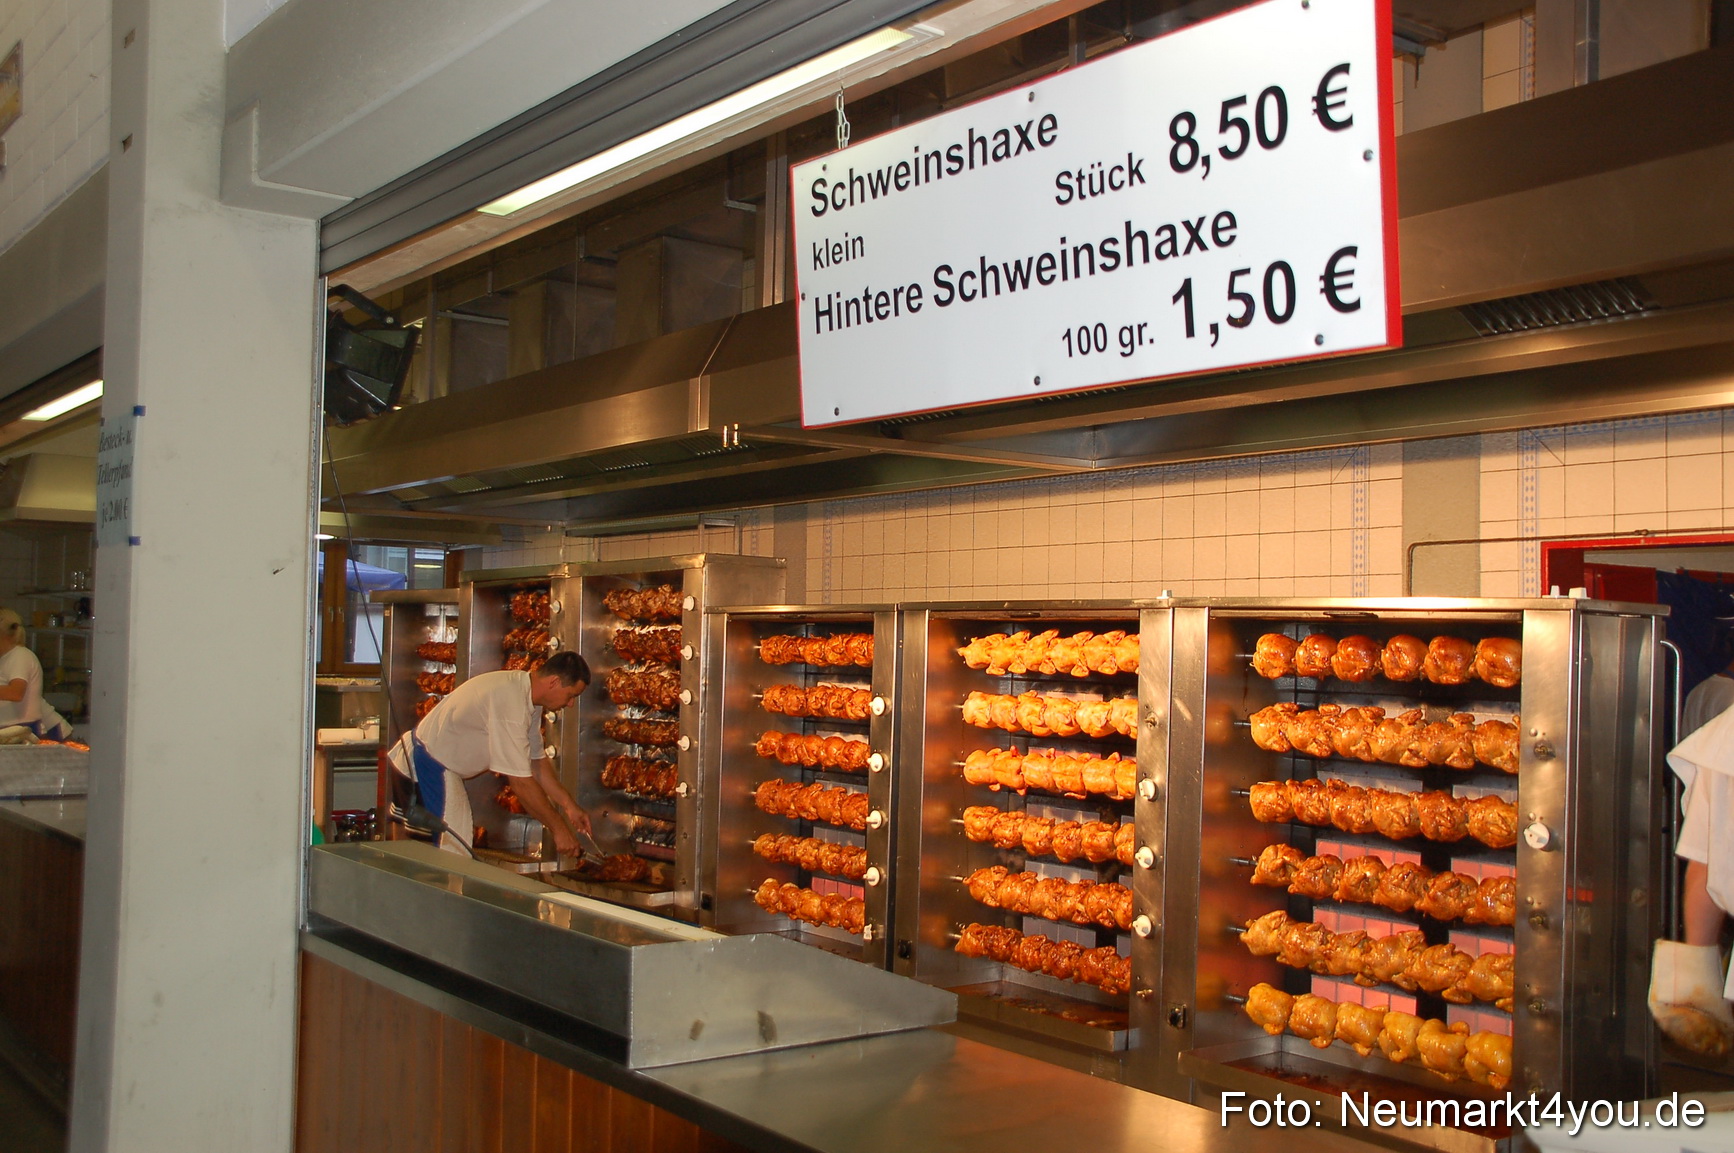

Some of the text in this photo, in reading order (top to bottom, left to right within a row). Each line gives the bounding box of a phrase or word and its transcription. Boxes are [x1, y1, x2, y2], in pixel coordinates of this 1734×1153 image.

[811, 112, 1059, 218] Schweinshaxe
[1054, 62, 1354, 206] Stück 8,50 €
[812, 232, 865, 271] klein
[814, 209, 1238, 335] Hintere Schweinshaxe
[1061, 245, 1362, 358] 100 gr. 1,50 €
